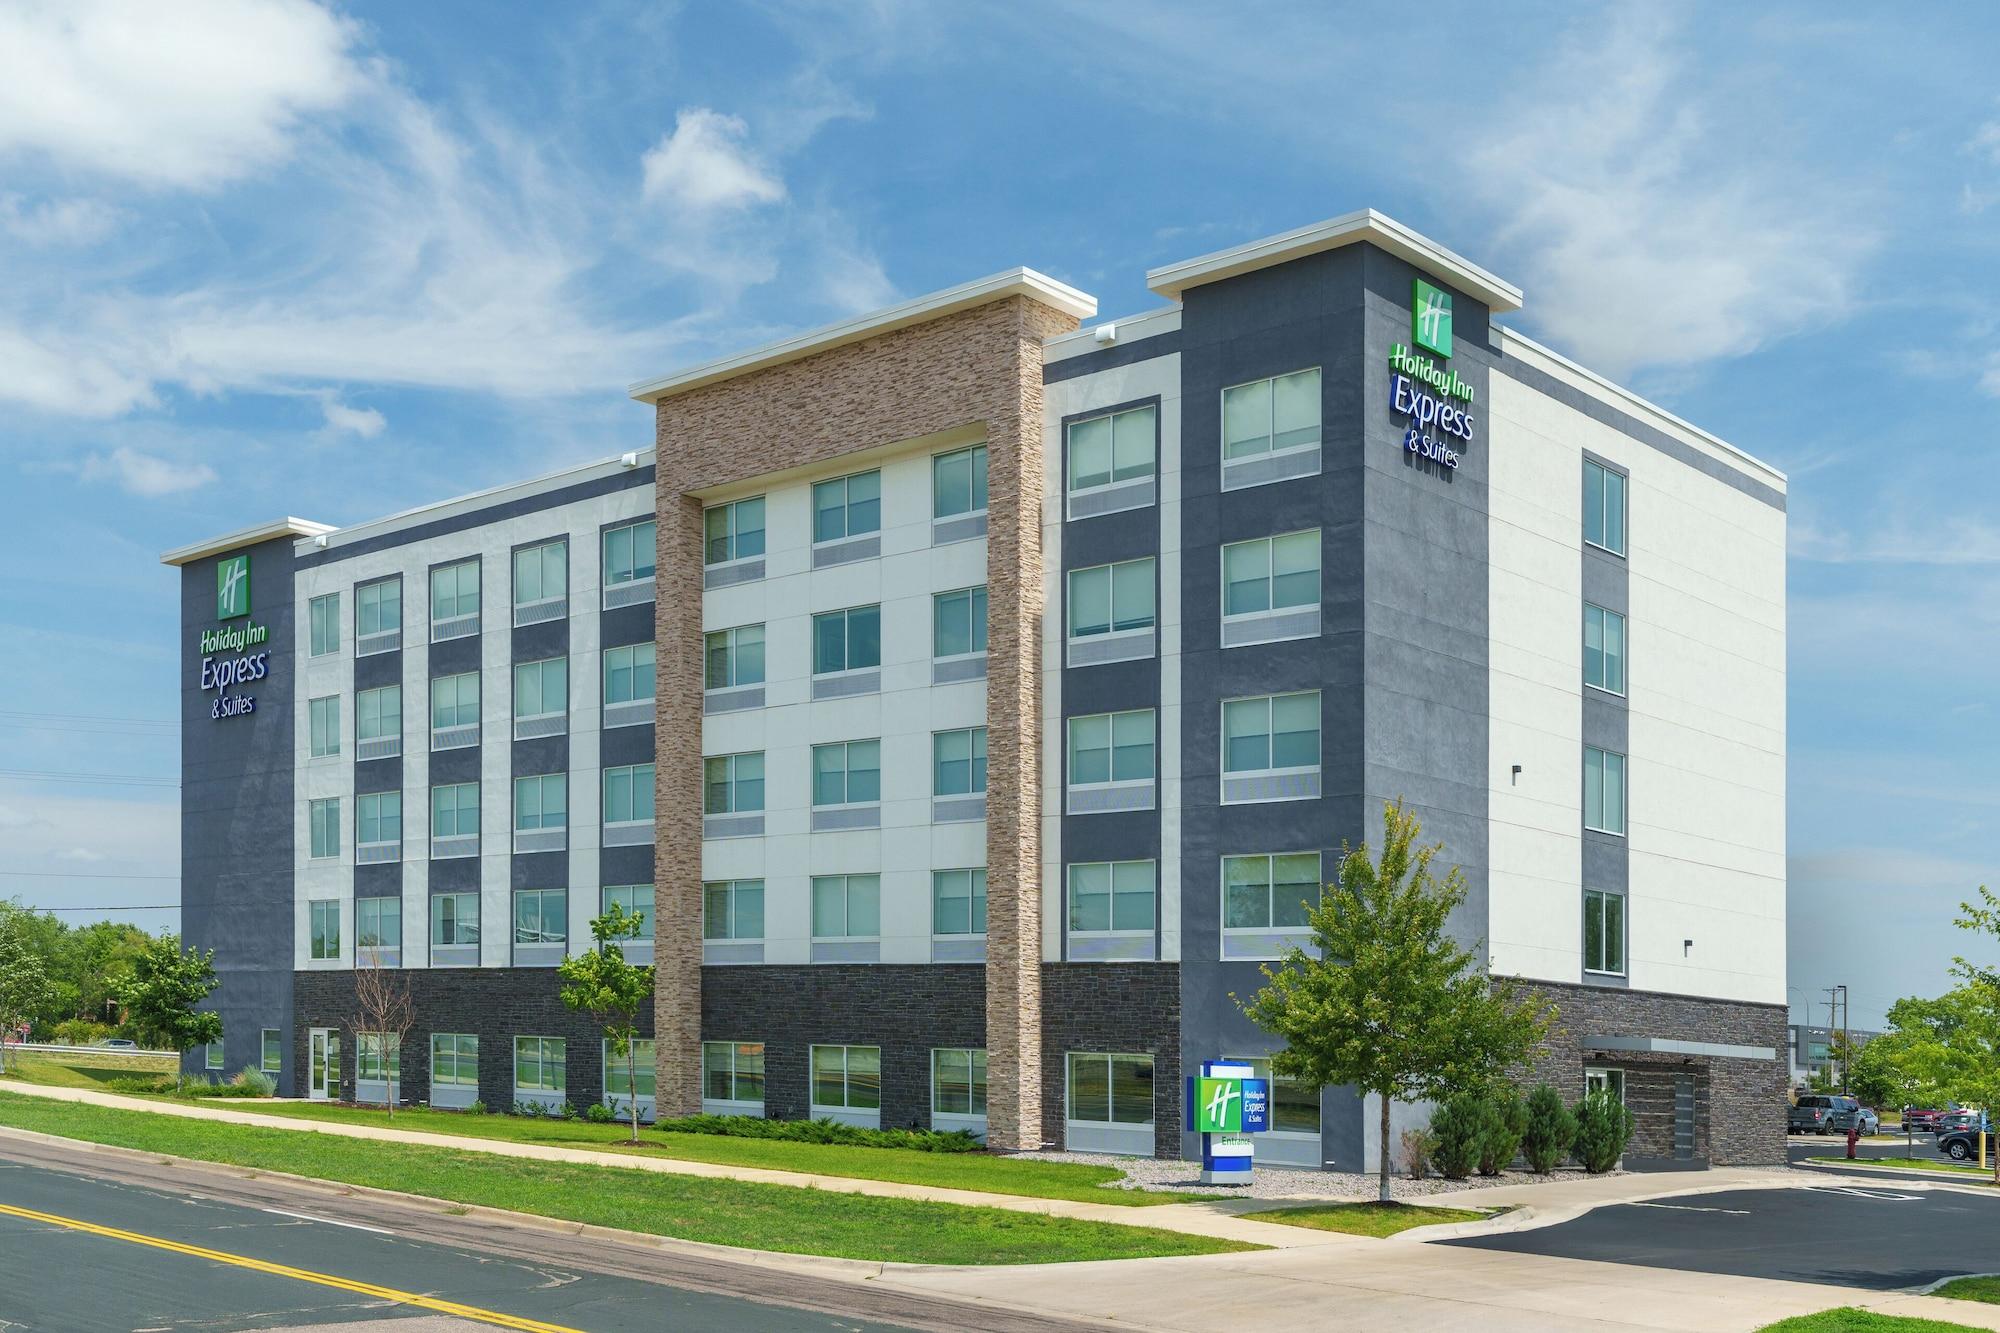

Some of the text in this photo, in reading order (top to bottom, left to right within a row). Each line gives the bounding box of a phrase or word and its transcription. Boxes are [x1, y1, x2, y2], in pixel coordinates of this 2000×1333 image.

[1389, 343, 1474, 402] Holiday Inn
[1394, 374, 1474, 441] Express
[1409, 429, 1459, 470] & Suites
[201, 620, 266, 655] Holiday Inn
[201, 653, 266, 696] Express
[212, 694, 253, 719] & Suites
[1244, 1100, 1265, 1115] Express
